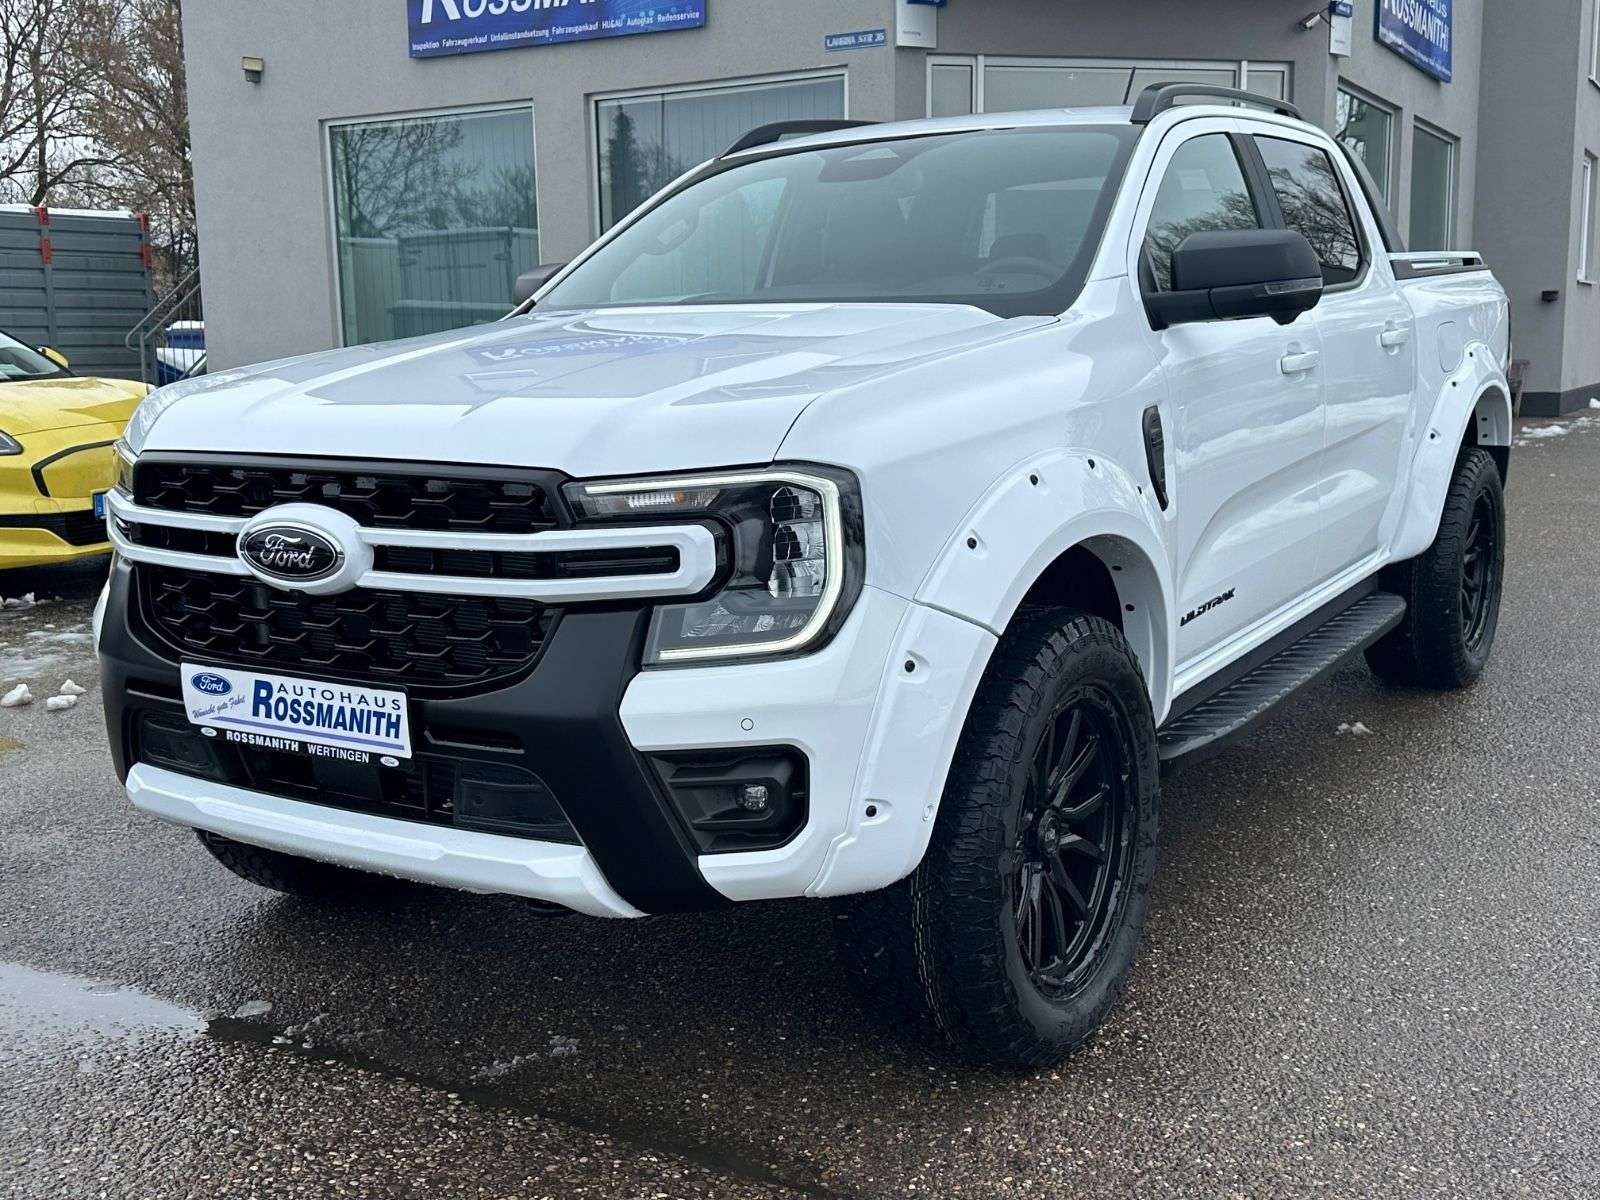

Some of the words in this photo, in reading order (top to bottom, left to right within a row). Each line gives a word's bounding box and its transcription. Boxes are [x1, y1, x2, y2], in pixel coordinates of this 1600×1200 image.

[627, 16, 653, 27] Autoglas
[260, 533, 316, 568] Ford
[1180, 587, 1236, 627] WILDTRAK
[200, 675, 224, 692] Ford
[277, 683, 401, 711] AUTOHAUS
[252, 679, 401, 739] ROSSMANITH
[226, 731, 299, 752] ROSSMANITH
[307, 743, 370, 764] WERTINGEN
